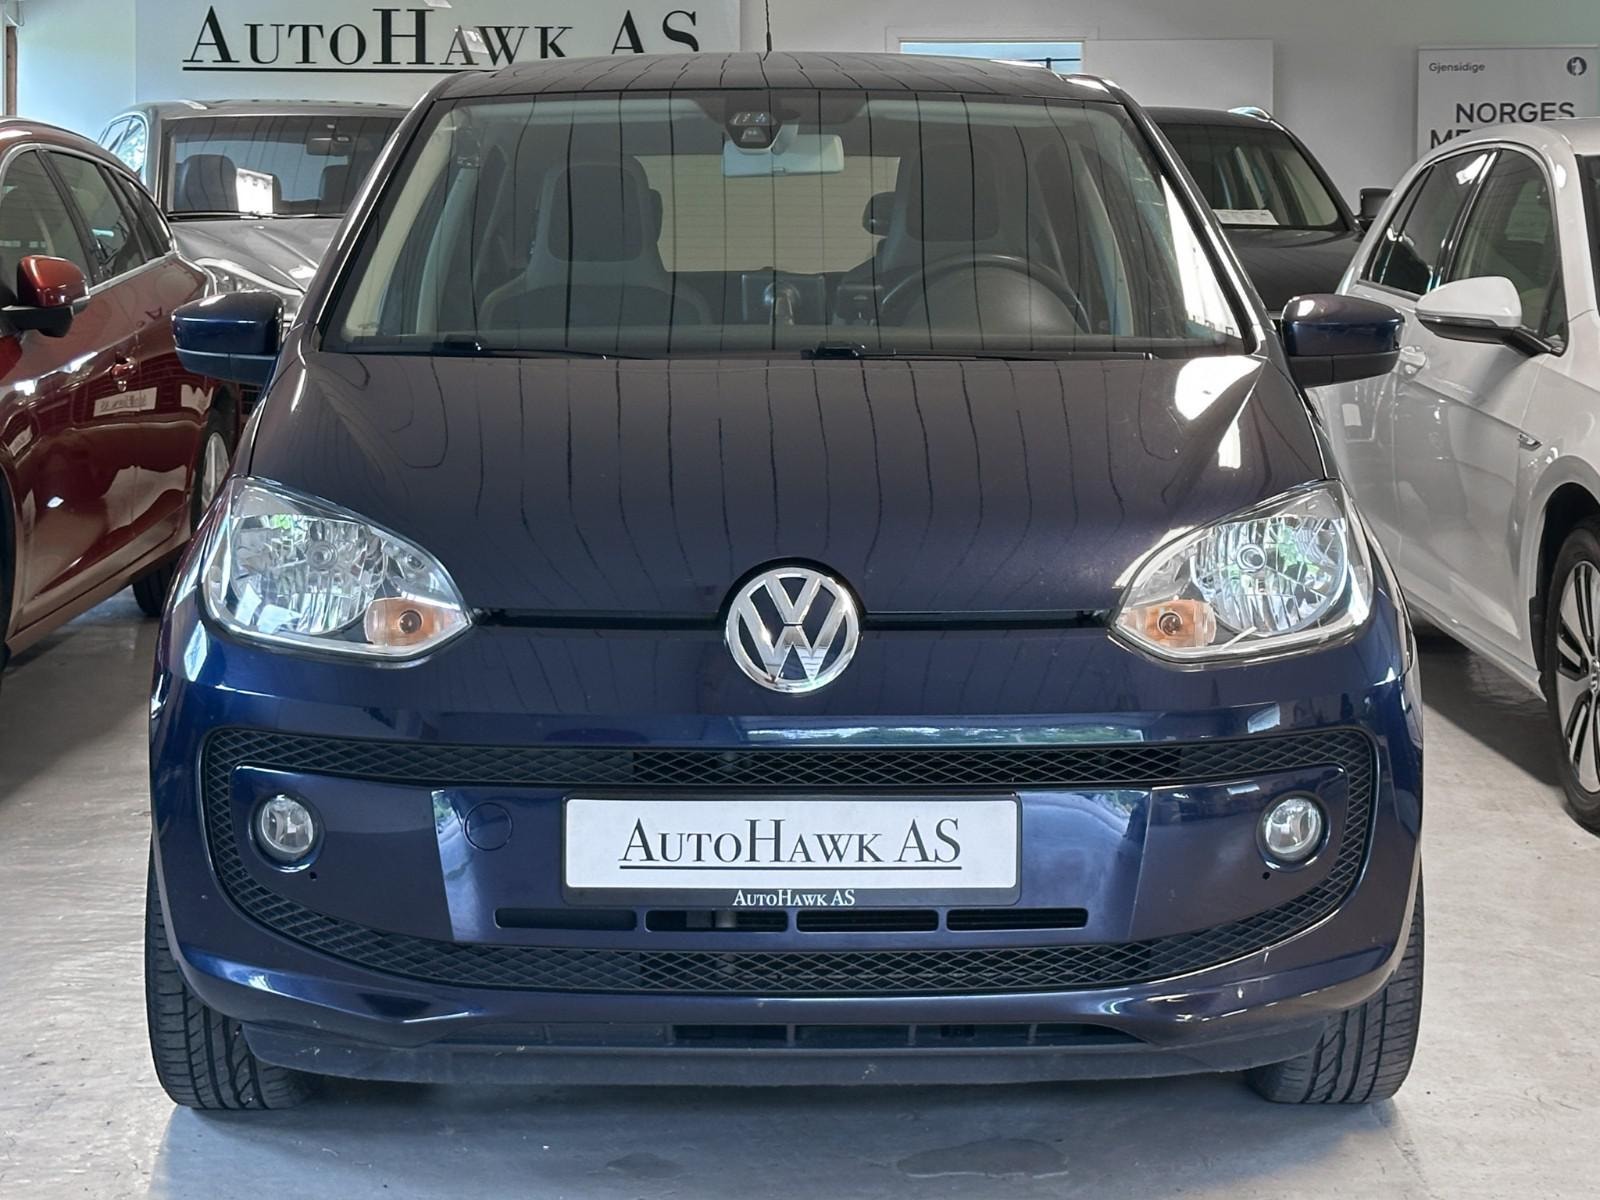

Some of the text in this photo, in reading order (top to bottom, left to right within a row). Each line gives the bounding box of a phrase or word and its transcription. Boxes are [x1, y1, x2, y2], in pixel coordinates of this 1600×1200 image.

[611, 9, 699, 54] AS
[1428, 62, 1485, 73] Gjensidige
[1456, 102, 1575, 123] NORGES
[897, 818, 961, 862] AS
[830, 889, 856, 906] AS
